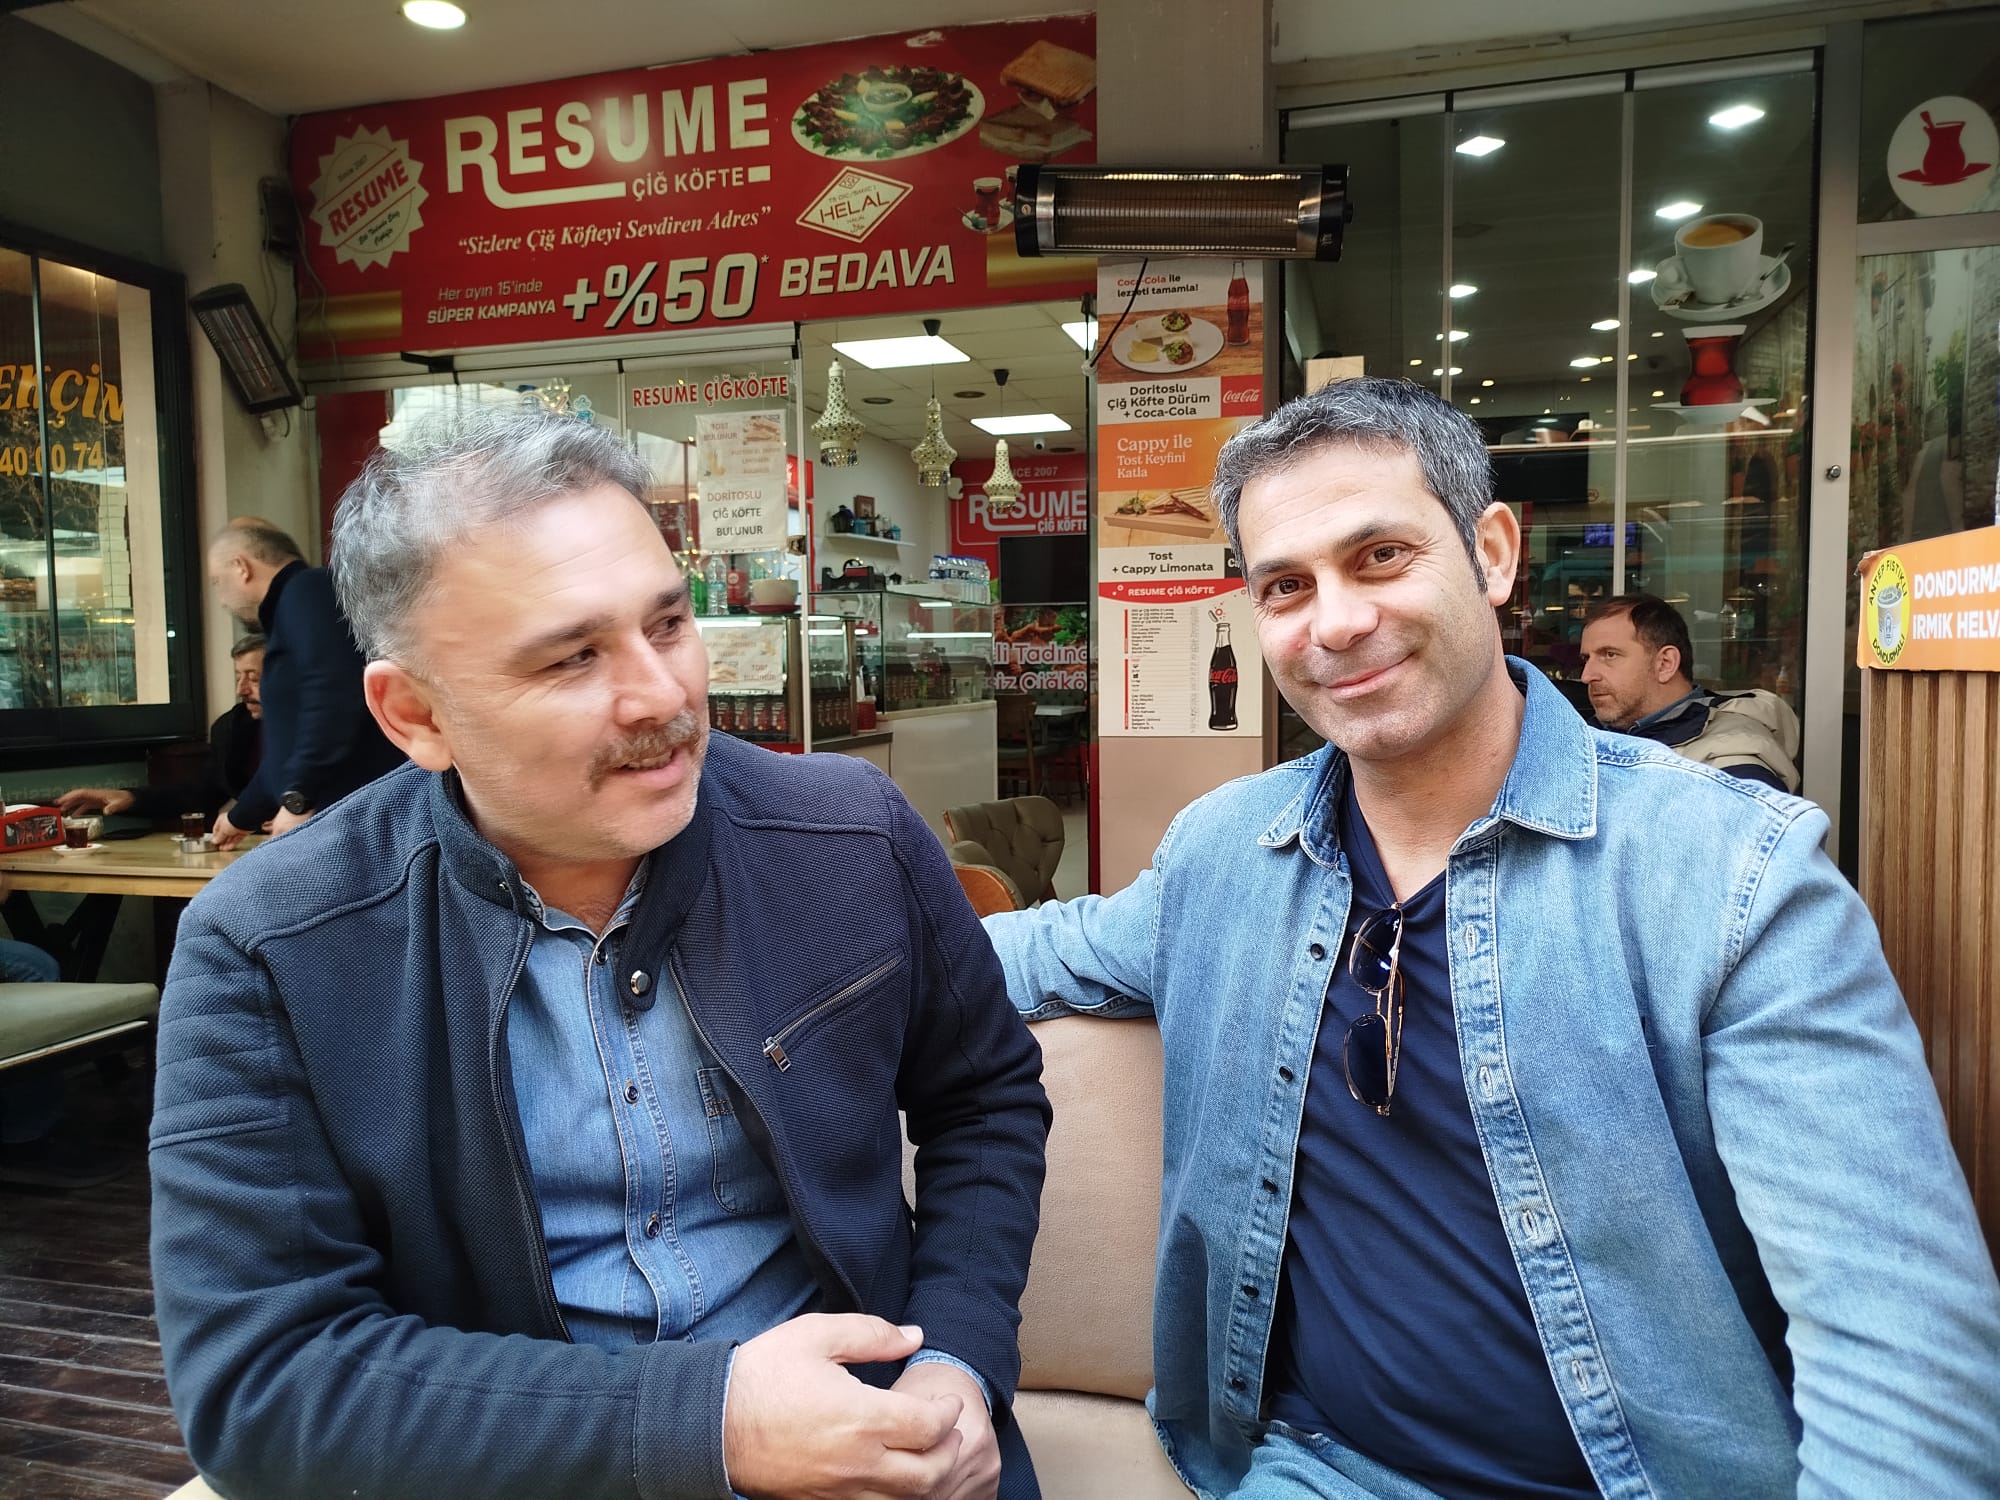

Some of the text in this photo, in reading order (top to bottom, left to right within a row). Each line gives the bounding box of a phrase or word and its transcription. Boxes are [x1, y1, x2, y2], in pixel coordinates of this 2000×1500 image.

[444, 78, 770, 209] RESUME
[632, 168, 744, 201] ÇİĞ KÖFTE
[328, 159, 409, 236] RESUME
[820, 192, 890, 223] HELAL
[527, 229, 555, 250] Çiğ
[561, 222, 622, 248] Köfteyi
[626, 217, 701, 239] Sevdiren
[779, 244, 955, 298] BEDAVA
[1117, 275, 1166, 287] Coc-Cola
[439, 287, 461, 300] Her
[465, 284, 493, 300] ayın
[1152, 283, 1199, 295] tamamla!
[427, 299, 556, 324] SÜPER KAMPANYA
[633, 373, 789, 408] RESUME ÇİĞKÖFTE
[1130, 384, 1187, 396] Doritoslu
[1107, 393, 1210, 411] Çiğ Köfte Dürüm
[1134, 406, 1197, 419] Coca-Cola
[1117, 433, 1193, 454] Cappy ile
[73, 440, 104, 473] 74
[1117, 452, 1186, 466] Tost Keyfini
[1117, 466, 1148, 479] Katla
[707, 489, 762, 502] DORİTOSLU
[713, 507, 761, 521] ÇİĞ KÖFTE
[716, 525, 763, 537] BULUNUR
[1037, 519, 1055, 534] ÇİĞ
[1149, 552, 1173, 560] Tost
[1121, 565, 1157, 575] Cappy
[1160, 563, 1214, 573] Limonata
[1128, 585, 1215, 597] RESUME ÇİĞ KÖFTE
[1957, 609, 2000, 640] HELV
